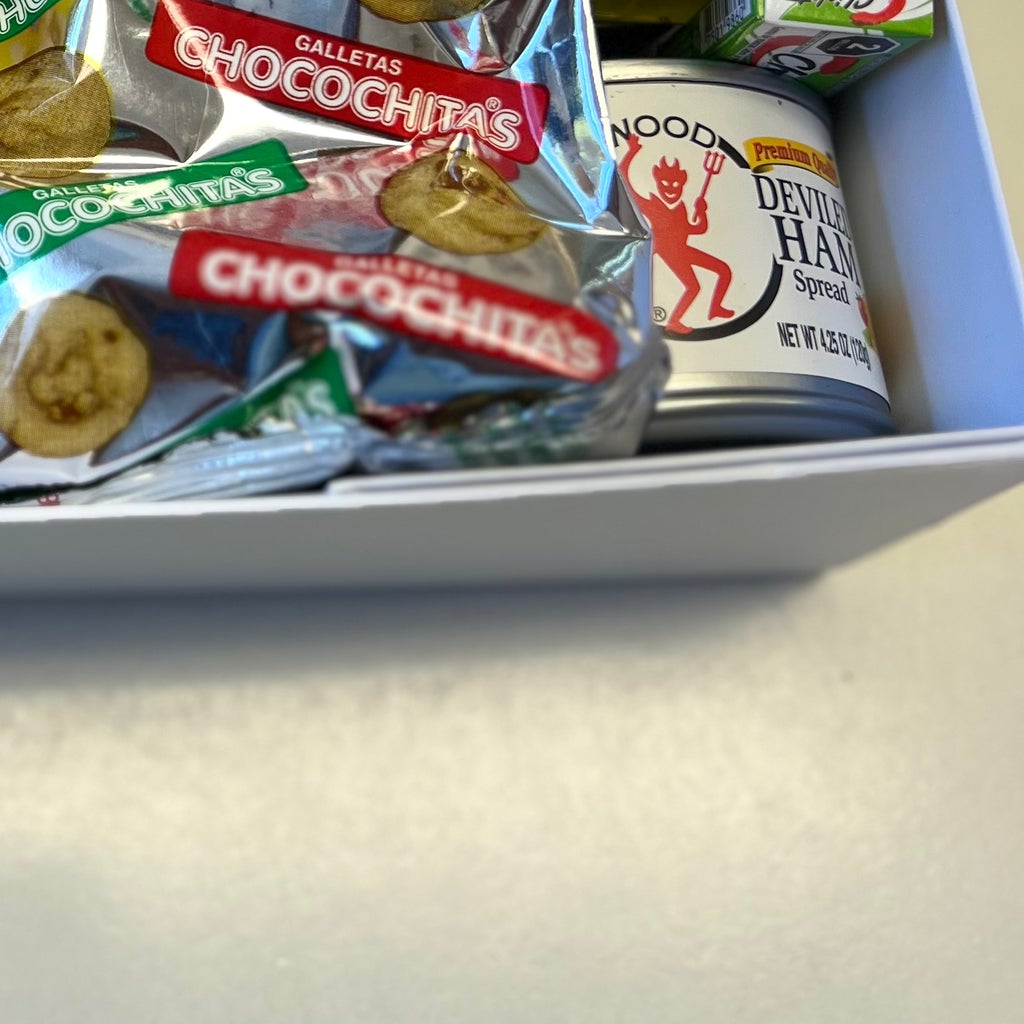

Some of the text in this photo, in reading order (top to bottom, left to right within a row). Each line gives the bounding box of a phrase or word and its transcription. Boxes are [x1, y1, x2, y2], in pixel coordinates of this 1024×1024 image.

[295, 34, 403, 76] GALLETAS
[752, 141, 811, 166] Premium
[32, 180, 139, 201] GALLETAS
[770, 213, 863, 289] HAM
[794, 267, 850, 306] Spread
[777, 321, 799, 349] NET
[799, 324, 818, 352] WT
[820, 327, 839, 356] 4.25
[839, 332, 852, 358] OZ
